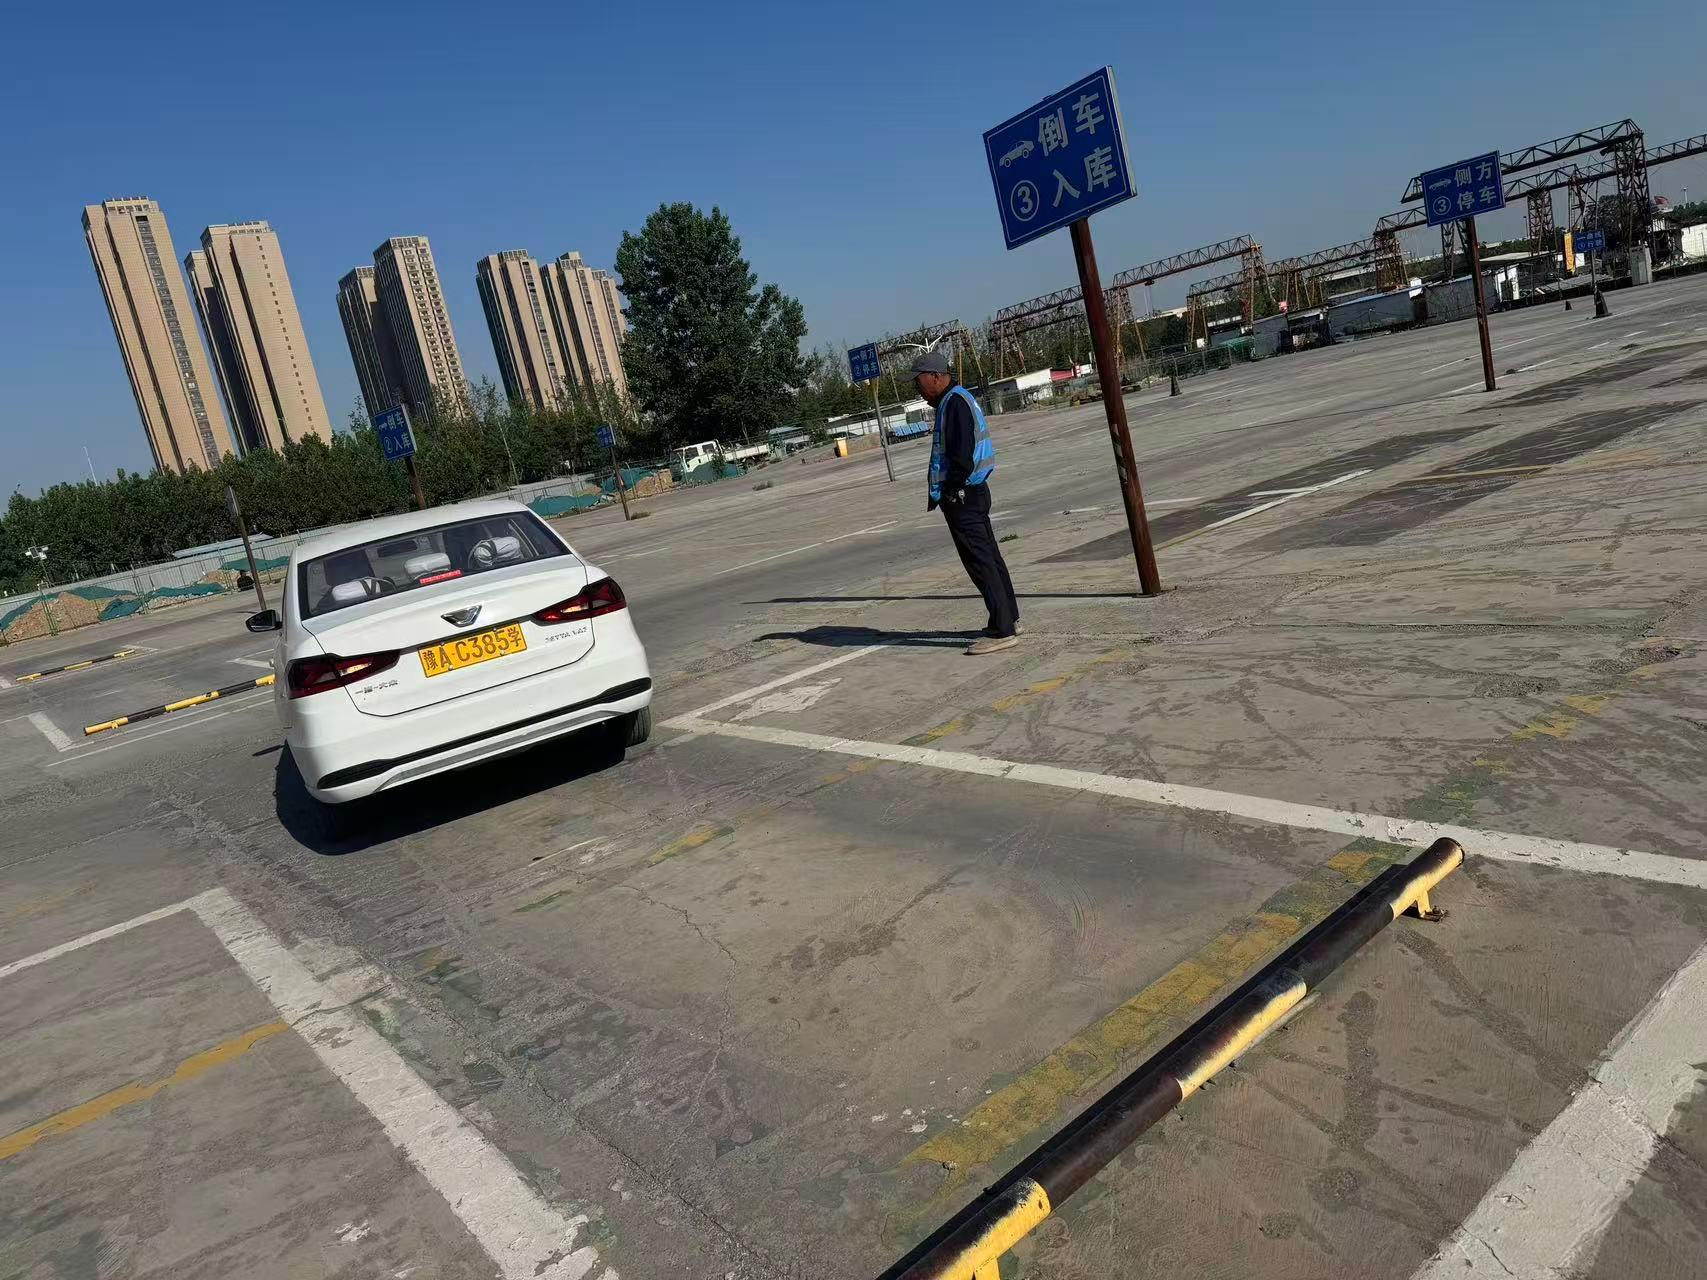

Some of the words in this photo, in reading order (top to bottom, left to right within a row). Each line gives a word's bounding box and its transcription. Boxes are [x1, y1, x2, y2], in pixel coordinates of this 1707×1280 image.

[1038, 92, 1104, 156] 倒车
[1053, 145, 1117, 207] 入库
[1455, 162, 1492, 187] 侧方
[1457, 186, 1496, 210] 停车
[387, 411, 404, 430] 倒车
[394, 432, 411, 451] 入库
